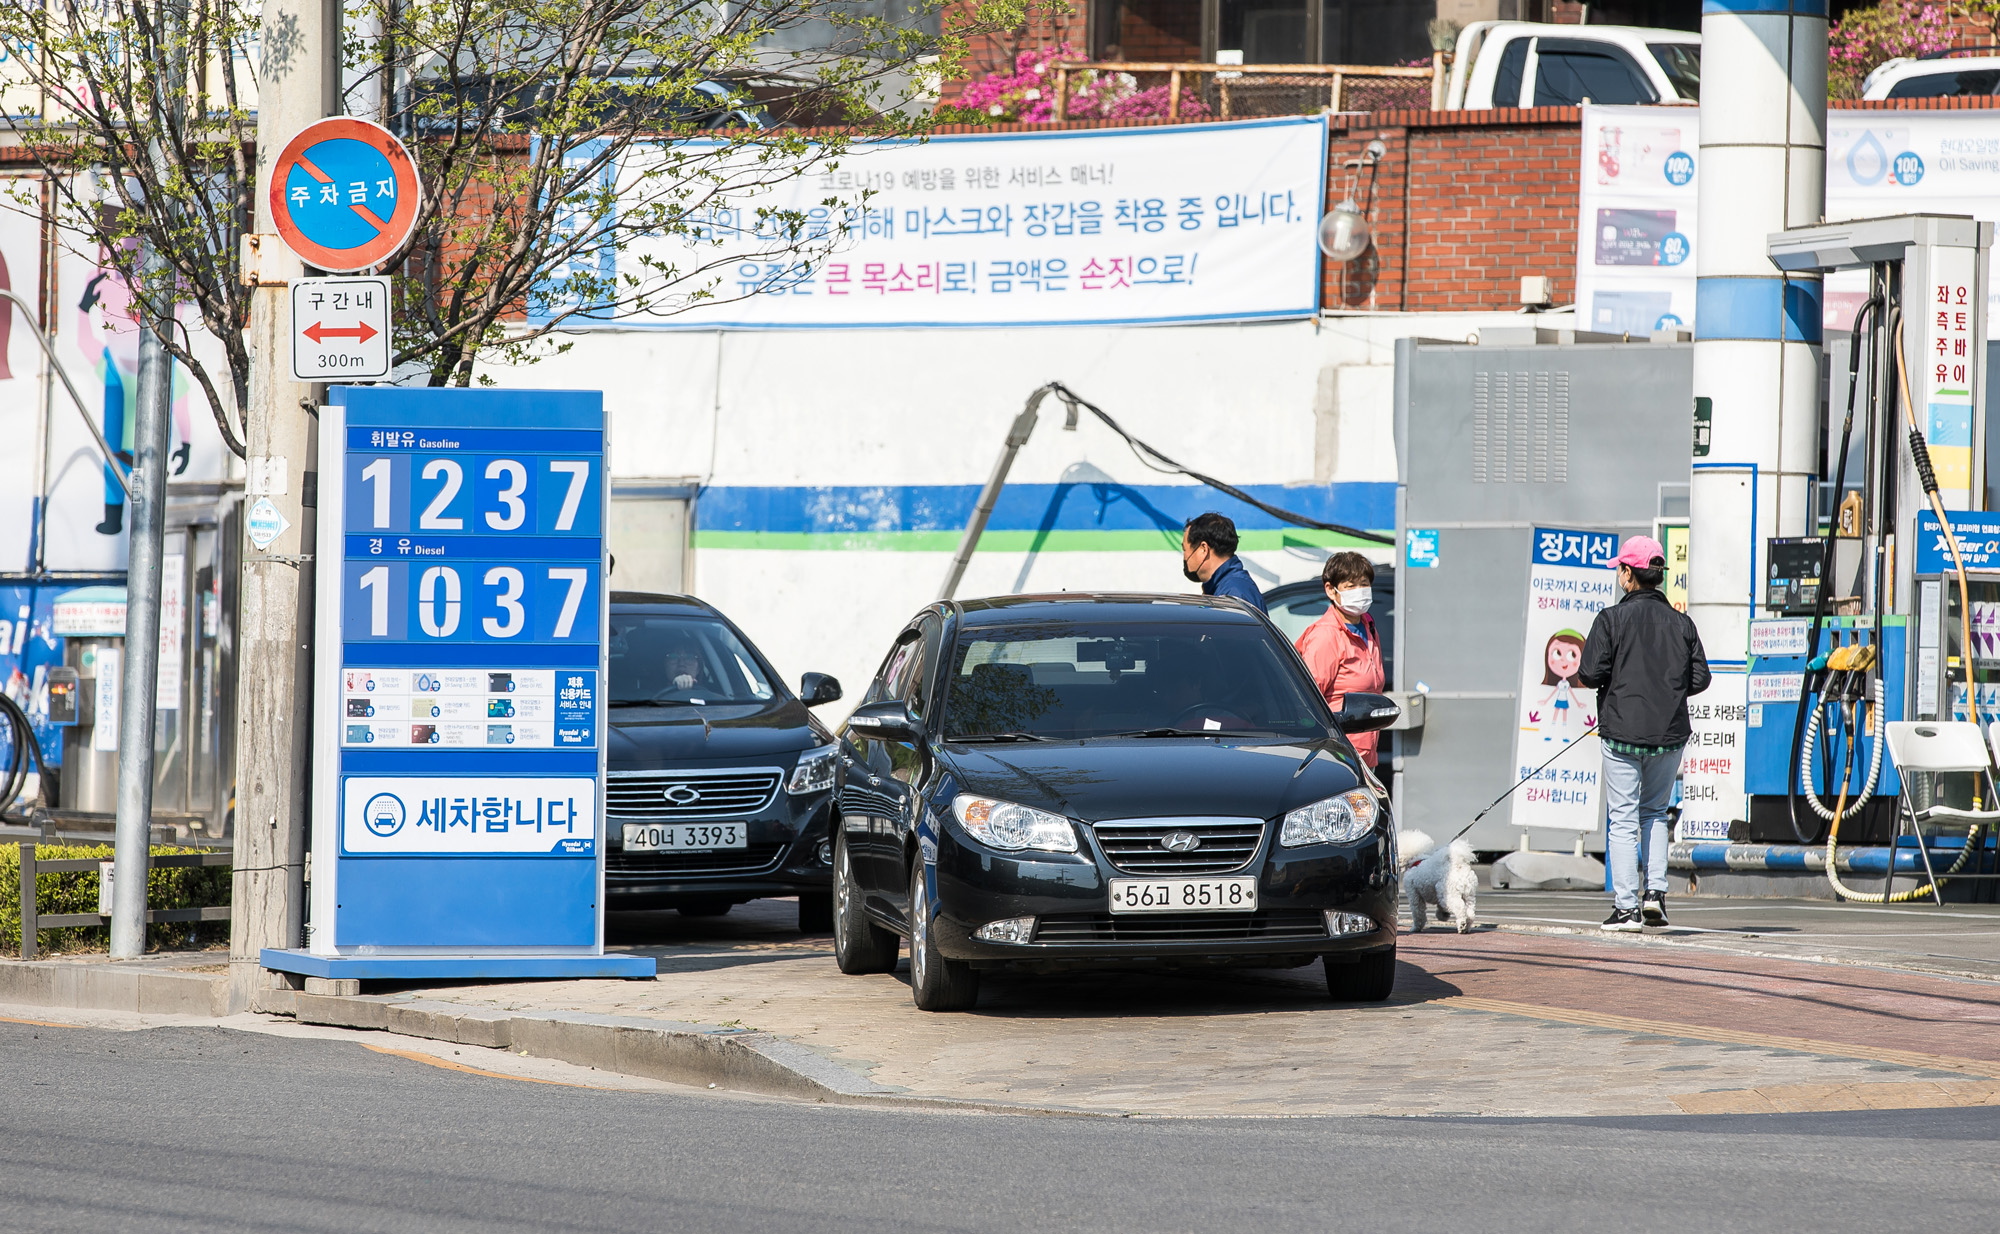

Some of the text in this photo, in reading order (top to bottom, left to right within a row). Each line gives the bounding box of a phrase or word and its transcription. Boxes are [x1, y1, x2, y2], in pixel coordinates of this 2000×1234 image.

[1939, 158, 1956, 171] Oil
[819, 162, 1116, 192] 코로나19 예방을 위한 서비스 매너!
[905, 203, 1013, 239] 마스크와
[1023, 200, 1105, 237] 장갑을
[1114, 197, 1168, 232] 착용
[1177, 197, 1205, 231] 중
[1215, 189, 1302, 229] 입니다.
[826, 263, 852, 295] 큰
[861, 258, 977, 296] 목소리로!
[988, 257, 1070, 294] 금액은
[1080, 252, 1199, 290] 손짓으로!
[311, 290, 374, 312] 구간내
[1935, 285, 1950, 383] 좌측주유
[1953, 285, 1968, 384] 오토바이
[317, 352, 366, 369] 300m
[370, 431, 460, 450] 휘발유 Gasoline
[361, 458, 590, 531] 1237
[414, 545, 445, 556] Diesel
[1539, 532, 1613, 566] 정지선
[1533, 577, 1613, 596] 이곳까지 오셔서
[359, 565, 589, 638] 1037
[1537, 596, 1606, 613] 정지해 주세요
[567, 676, 585, 688] 제휴
[559, 688, 592, 700] 신용카드
[559, 700, 592, 710] 서비스 안내
[1687, 705, 1711, 721] 유소로
[1703, 731, 1736, 748] 드리며
[1520, 765, 1597, 786] 협조해 주셔서
[1526, 787, 1588, 805] 감사합니다
[416, 796, 578, 834] 세차합니다
[635, 826, 736, 847] 40너 3393
[1126, 882, 1243, 907] 56고 8518
